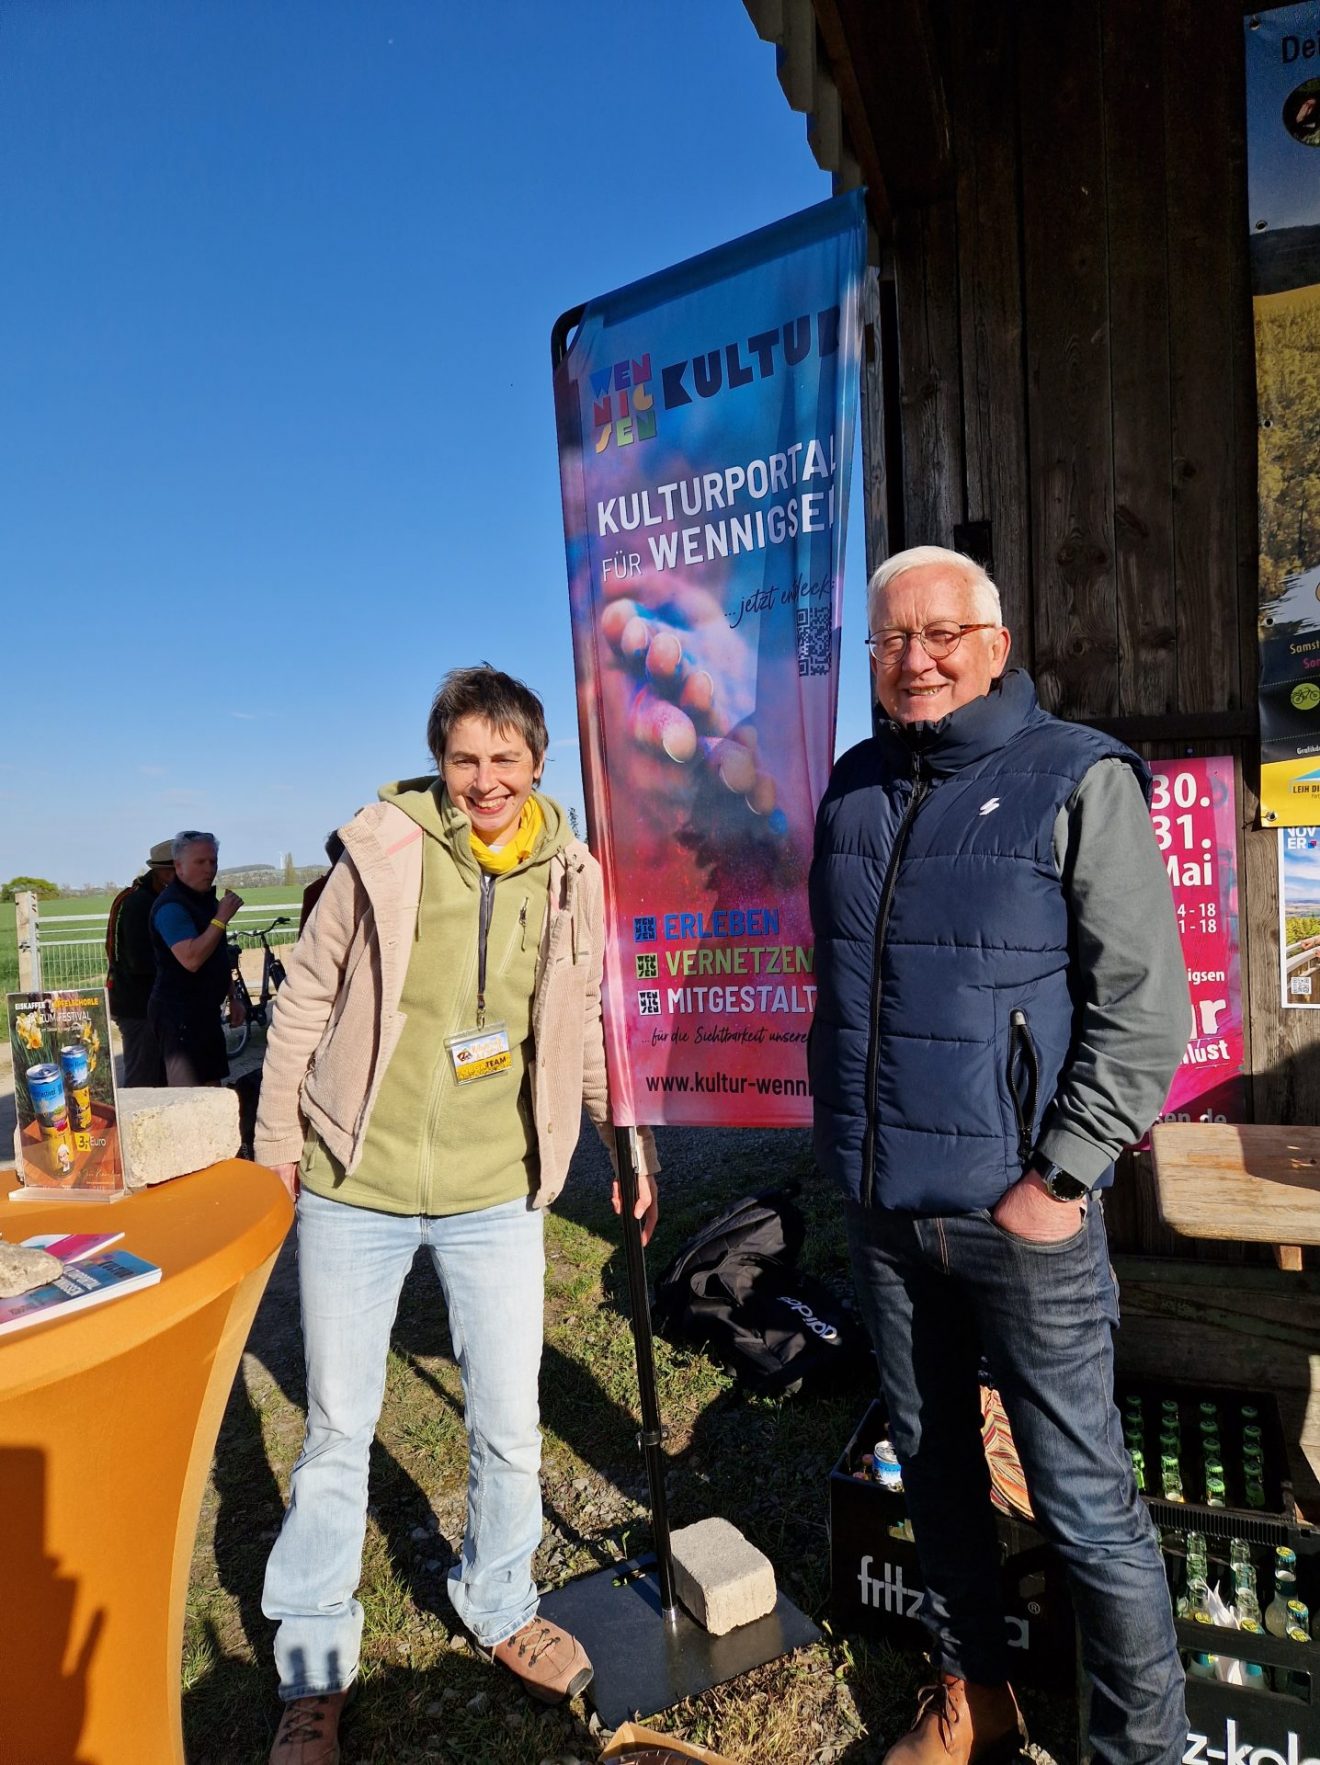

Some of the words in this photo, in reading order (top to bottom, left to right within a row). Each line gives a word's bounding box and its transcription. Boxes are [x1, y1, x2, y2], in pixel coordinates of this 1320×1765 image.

[602, 550, 642, 582] FÜR
[1151, 772, 1211, 810] 30.
[1152, 814, 1212, 851] 31.
[1287, 837, 1307, 850] ER
[1199, 903, 1216, 917] 18
[664, 909, 780, 940] ERLEBEN
[1200, 919, 1217, 933] 18
[665, 946, 815, 976] VERNETZEN
[1187, 968, 1225, 985] igsen
[667, 986, 817, 1014] MITGESTALT
[671, 1026, 689, 1042] die
[486, 1056, 506, 1068] TEAM
[90, 1135, 106, 1147] Euro
